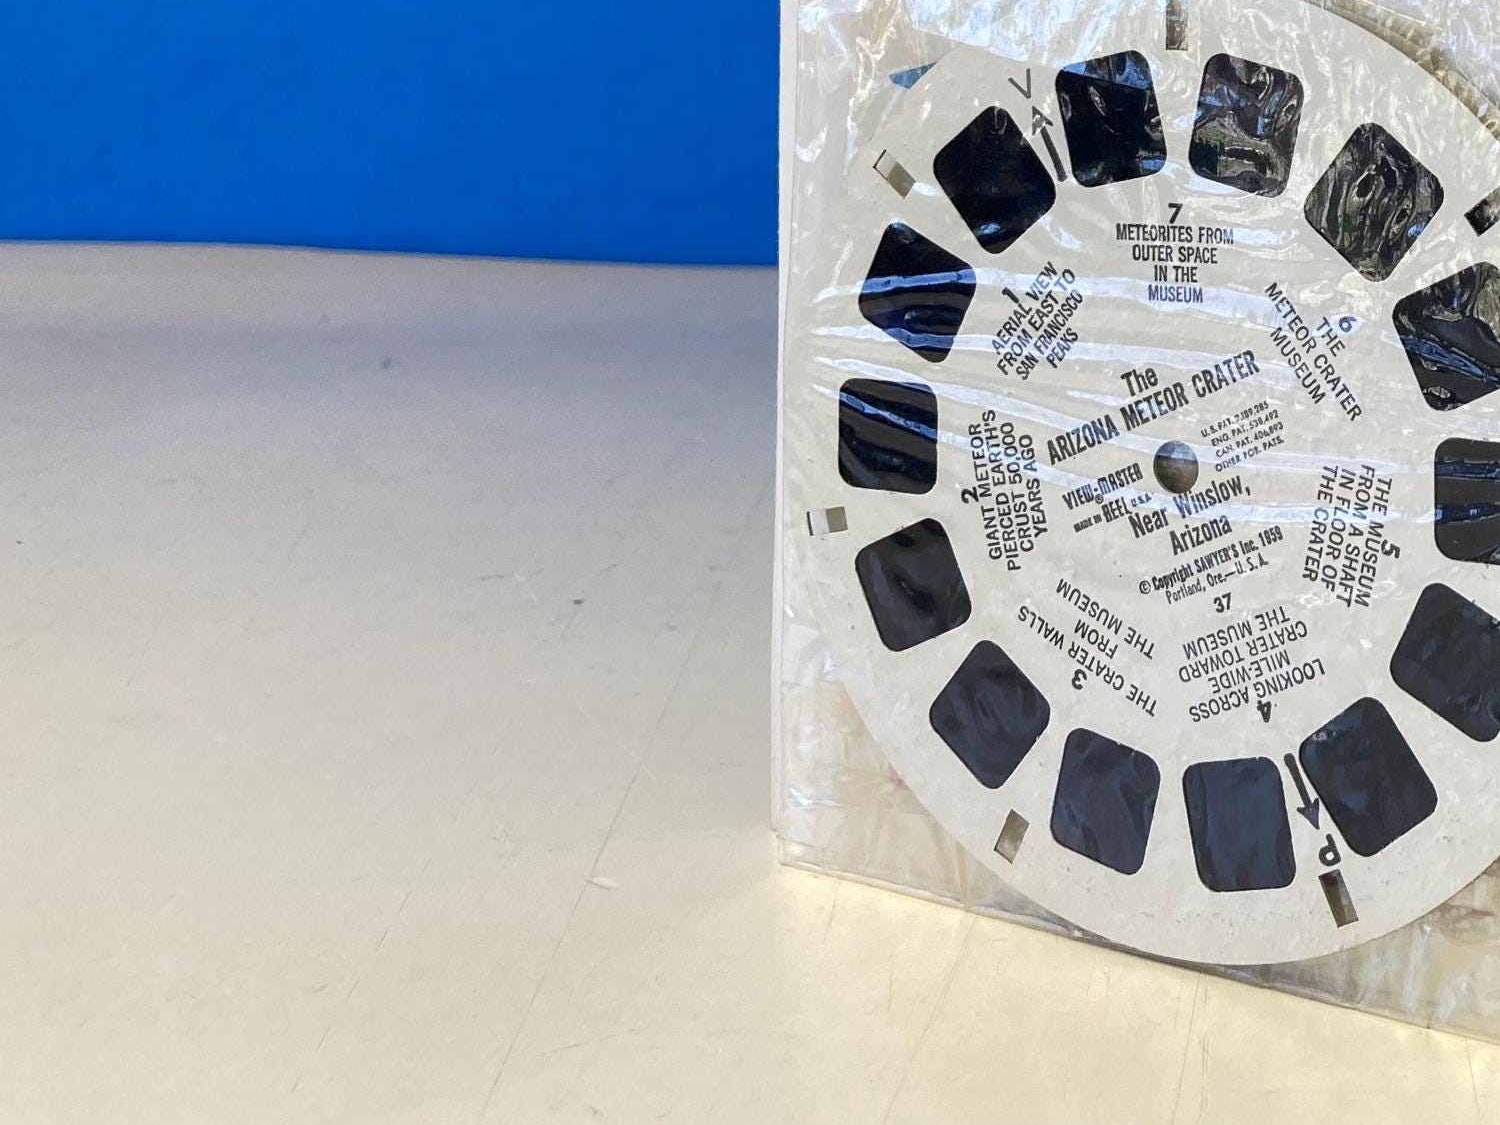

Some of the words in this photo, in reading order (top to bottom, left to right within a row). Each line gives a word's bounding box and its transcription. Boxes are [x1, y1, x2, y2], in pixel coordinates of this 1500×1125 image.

[1116, 223, 1193, 243] METEORITES
[1199, 226, 1234, 244] FROM
[1167, 203, 1183, 224] 7
[1132, 244, 1173, 262] OUTER
[1178, 246, 1218, 264] SPACE
[1154, 265, 1168, 282] IN
[1173, 266, 1198, 283] THE
[991, 303, 1032, 355] AERIAL
[1025, 261, 1058, 301] VIEW
[1001, 287, 1019, 304] 1
[1148, 284, 1203, 303] MUSEUM
[997, 328, 1033, 376] FROM
[1028, 290, 1059, 332] EAST
[1053, 269, 1075, 291] TO
[1016, 352, 1039, 380] SAN
[1033, 289, 1083, 355] FRANCISCO
[1316, 316, 1346, 357] THE
[1338, 316, 1357, 333] 6
[1046, 327, 1078, 369] PEAKS
[1265, 282, 1317, 354] METEOR
[1314, 354, 1362, 421] CRATER
[1270, 327, 1326, 404] MUSEUM
[1120, 367, 1158, 397] The
[1047, 414, 1120, 465] ARIZONA
[1120, 382, 1189, 431] METEOR
[1192, 349, 1260, 398] CRATER
[982, 409, 1006, 486] EARTH'S
[1231, 425, 1249, 437] PAT.
[1235, 436, 1253, 448] PAT.
[969, 423, 992, 498] METEOR
[1000, 422, 1023, 484] 50,000
[1018, 434, 1037, 472] AGO
[1215, 454, 1241, 472] OTHER
[961, 487, 979, 504] 2
[1062, 462, 1143, 510] VIEW-MASTER
[1317, 466, 1338, 504] THE
[1338, 468, 1356, 490] IN
[1352, 464, 1375, 520] FROM
[1372, 478, 1392, 516] THE
[1011, 490, 1034, 552] CRUST
[1026, 477, 1048, 538] YEARS
[1101, 496, 1133, 523] REEL
[1128, 507, 1169, 538] Near
[1173, 475, 1251, 518] Winslow,
[981, 505, 1002, 560] GIANT
[995, 492, 1021, 571] PIERCED
[1169, 515, 1232, 556] Arizona
[1302, 507, 1329, 582] CRATER
[1325, 496, 1351, 560] FLOOR
[1348, 523, 1364, 537] A
[1152, 562, 1194, 590] Copyright
[1194, 543, 1239, 573] SAWYER'S
[1239, 540, 1259, 555] Inc.
[1258, 525, 1283, 547] 1959
[1354, 520, 1384, 607] MUSEUM
[1381, 539, 1401, 559] 5
[1165, 579, 1206, 604] Portland,
[1321, 564, 1338, 592] OF
[1336, 543, 1360, 608] SHAFT
[1056, 578, 1123, 635] MUSEUM
[1214, 592, 1232, 613] 37
[1255, 606, 1290, 631] THE
[1018, 605, 1064, 650] WALLS
[1074, 619, 1118, 659] FROM
[1124, 627, 1155, 660] THE
[1183, 620, 1253, 660] MUSEUM
[1246, 621, 1308, 656] CRATER
[1068, 641, 1124, 691] CRATER
[1071, 669, 1087, 690] 3
[1178, 646, 1245, 682] TOWARD
[1208, 649, 1291, 694] MILE-WIDE
[1253, 658, 1325, 698] LOOKING
[1126, 684, 1157, 717] THE
[1189, 687, 1249, 723] ACROSS
[1257, 700, 1272, 723] 4
